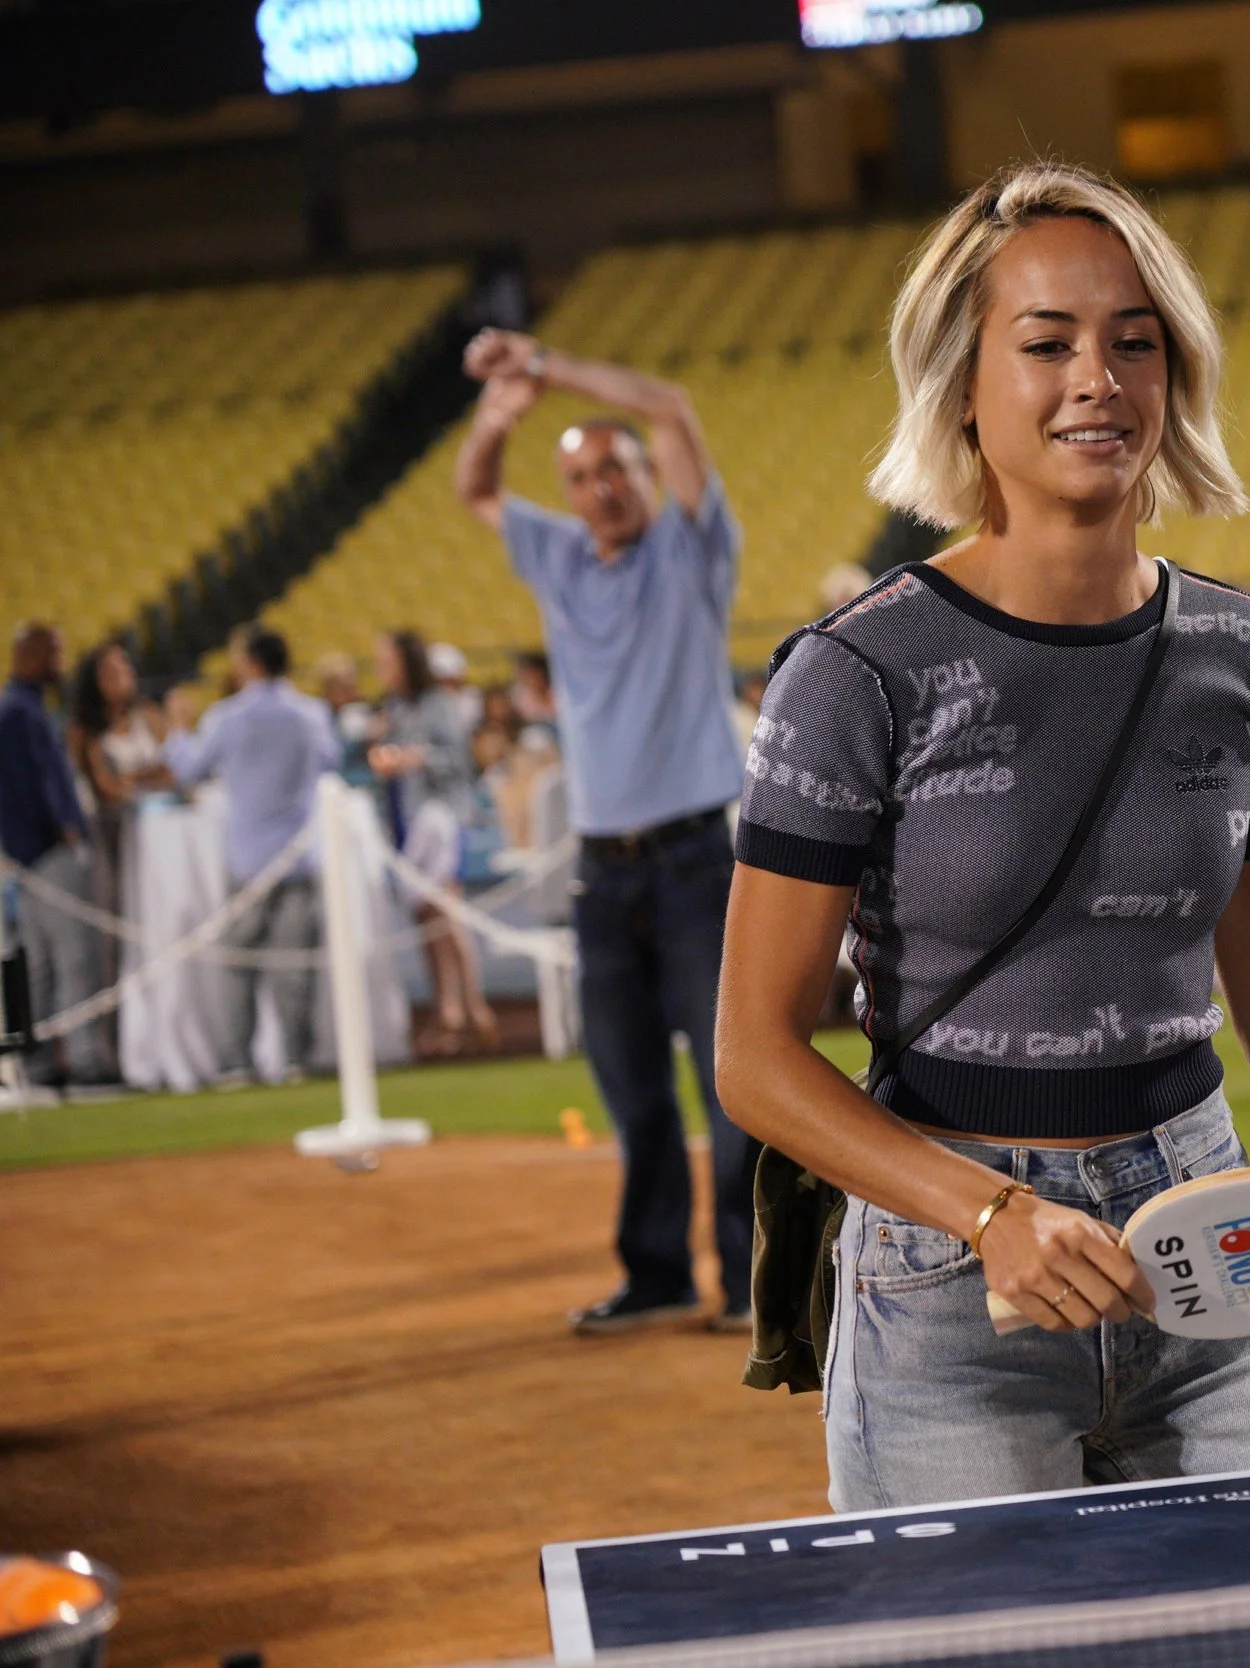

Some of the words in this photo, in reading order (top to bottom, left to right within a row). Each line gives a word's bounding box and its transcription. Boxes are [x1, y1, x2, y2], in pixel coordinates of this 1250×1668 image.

[907, 657, 982, 710] you
[1176, 774, 1227, 793] adidas
[1090, 888, 1199, 918] can't
[926, 1022, 1008, 1056] you
[1026, 1003, 1125, 1057] can't
[1155, 1236, 1207, 1318] SPIN
[1074, 1495, 1209, 1516] Hospital
[679, 1521, 957, 1561] SPIN
